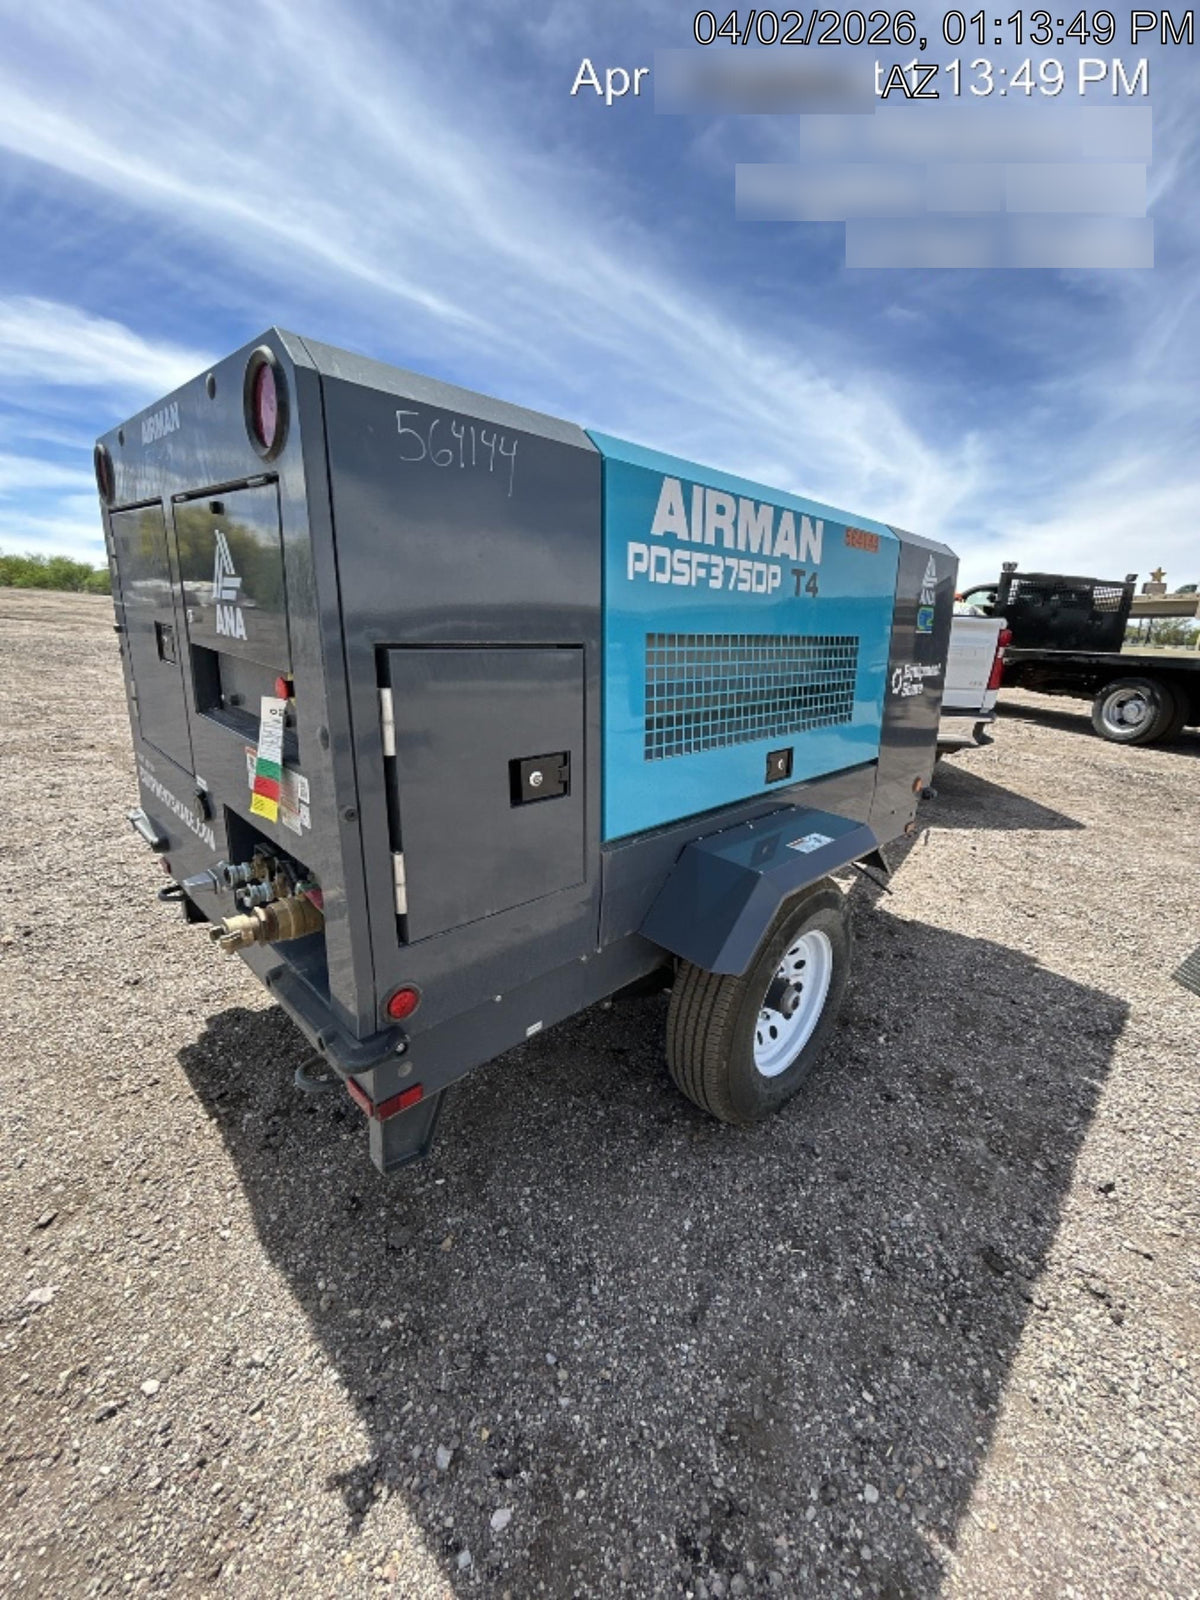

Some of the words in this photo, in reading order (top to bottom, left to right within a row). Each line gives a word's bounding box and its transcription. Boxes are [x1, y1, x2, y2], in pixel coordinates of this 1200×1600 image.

[396, 409, 518, 497] 564144
[650, 475, 824, 566] AIRMAN
[790, 568, 819, 598] T4
[216, 604, 248, 641] ANA
